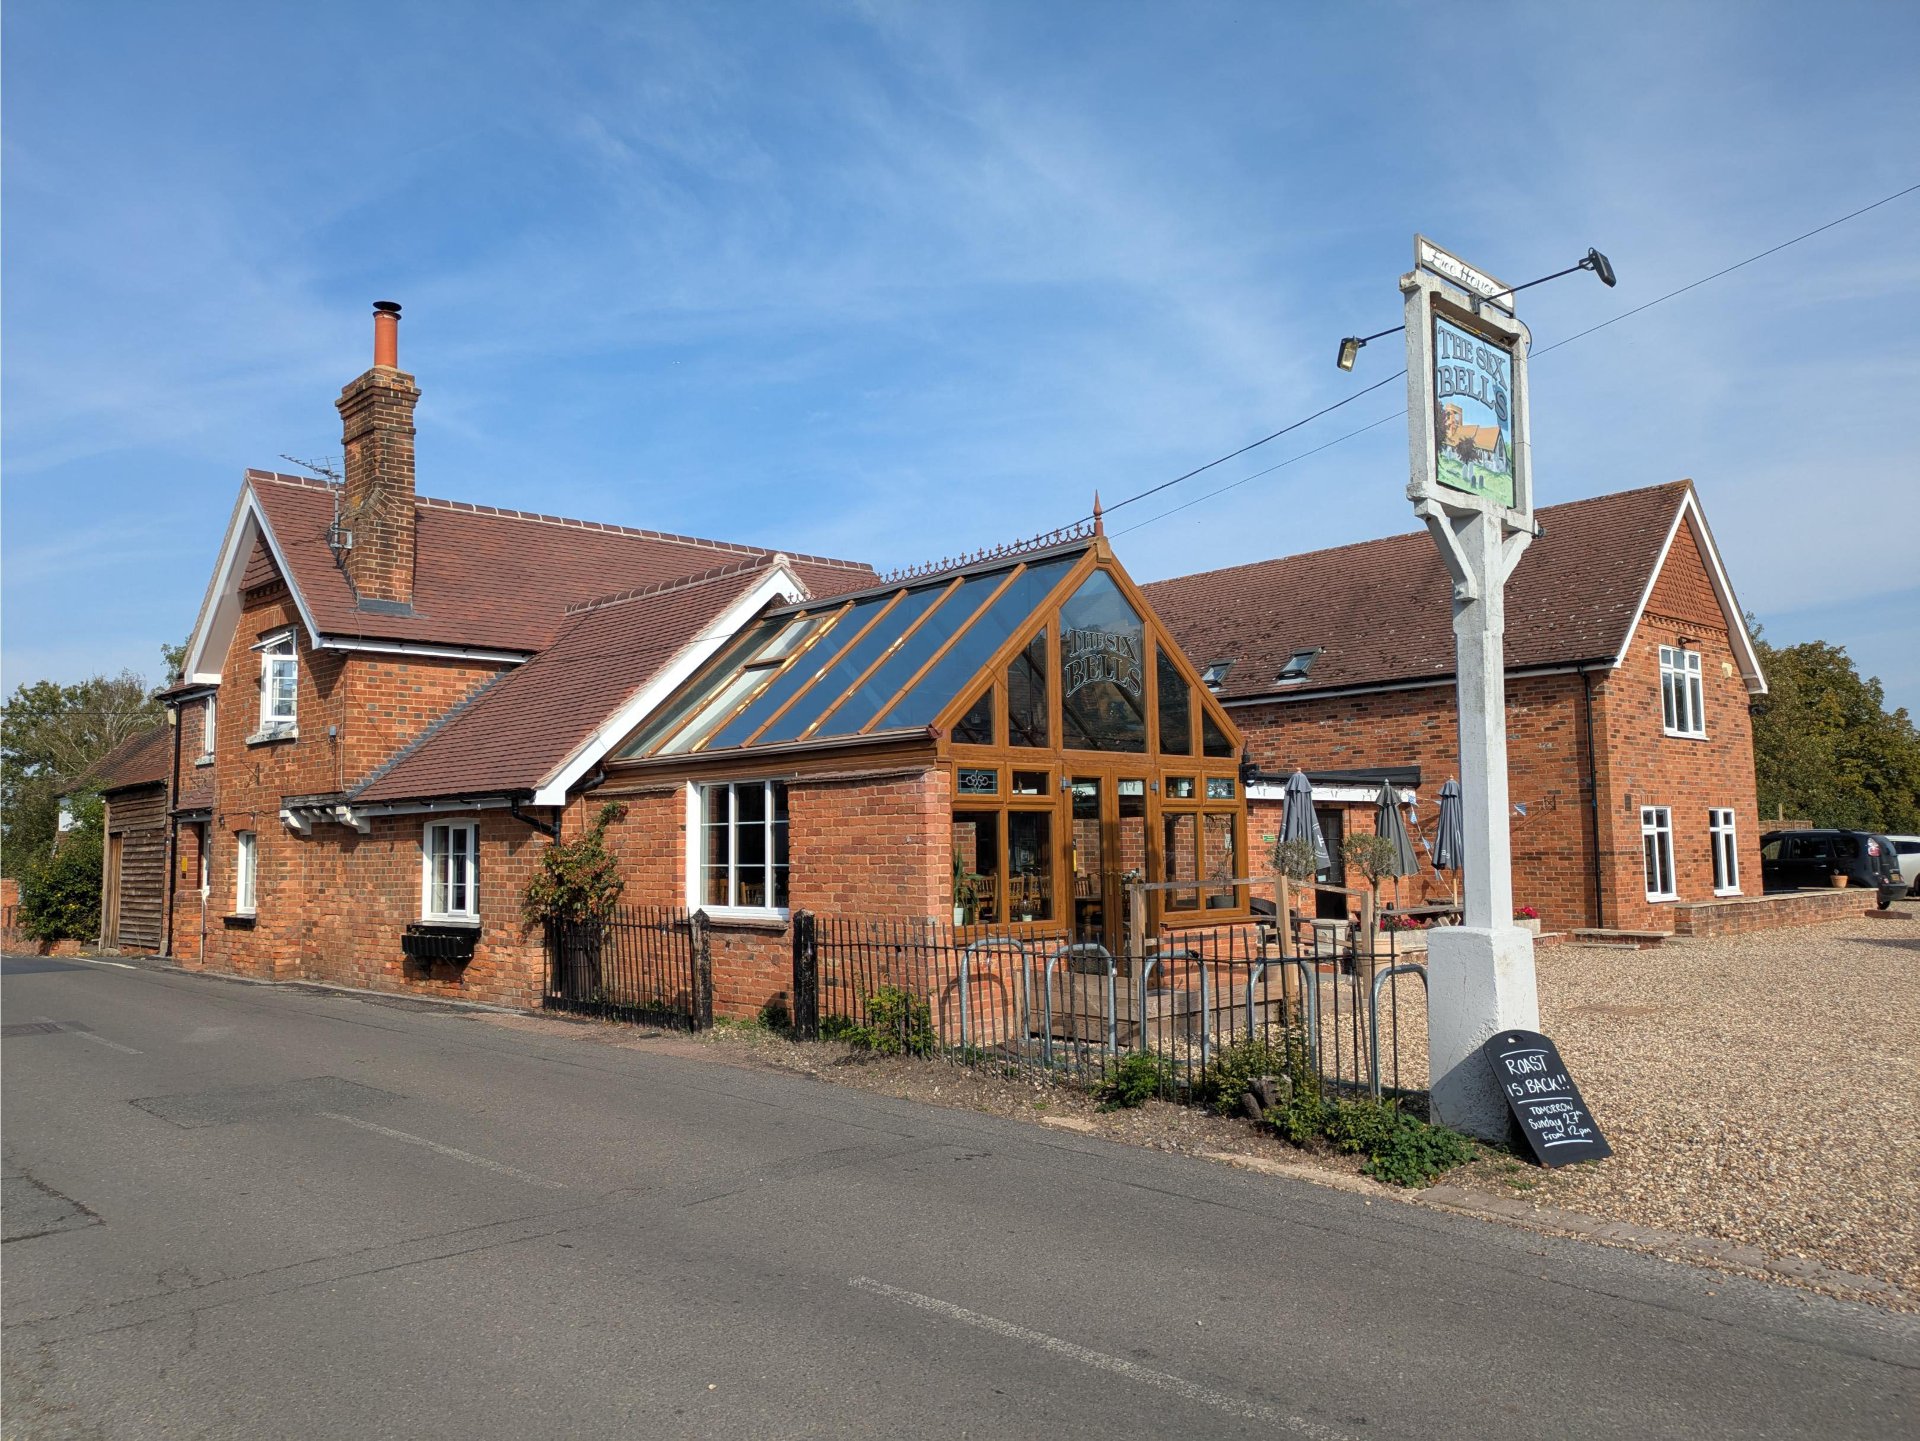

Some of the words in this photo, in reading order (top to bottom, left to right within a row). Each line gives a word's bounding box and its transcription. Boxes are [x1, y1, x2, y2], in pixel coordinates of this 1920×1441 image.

[1460, 266, 1495, 295] House
[1438, 326, 1473, 363] THE
[1476, 346, 1507, 391] SIX
[1438, 365, 1507, 421] BELLS
[1068, 628, 1104, 657] THE
[1105, 633, 1139, 664] SIX
[1064, 653, 1142, 698] BELLS
[1505, 1055, 1547, 1075] ROAST
[1507, 1083, 1523, 1096] IS
[1525, 1075, 1570, 1094] BACK!!
[1529, 1101, 1574, 1115] TOMORROW
[1528, 1116, 1564, 1133] Sunday
[1542, 1131, 1566, 1141] From
[1567, 1125, 1592, 1137] 12pm
